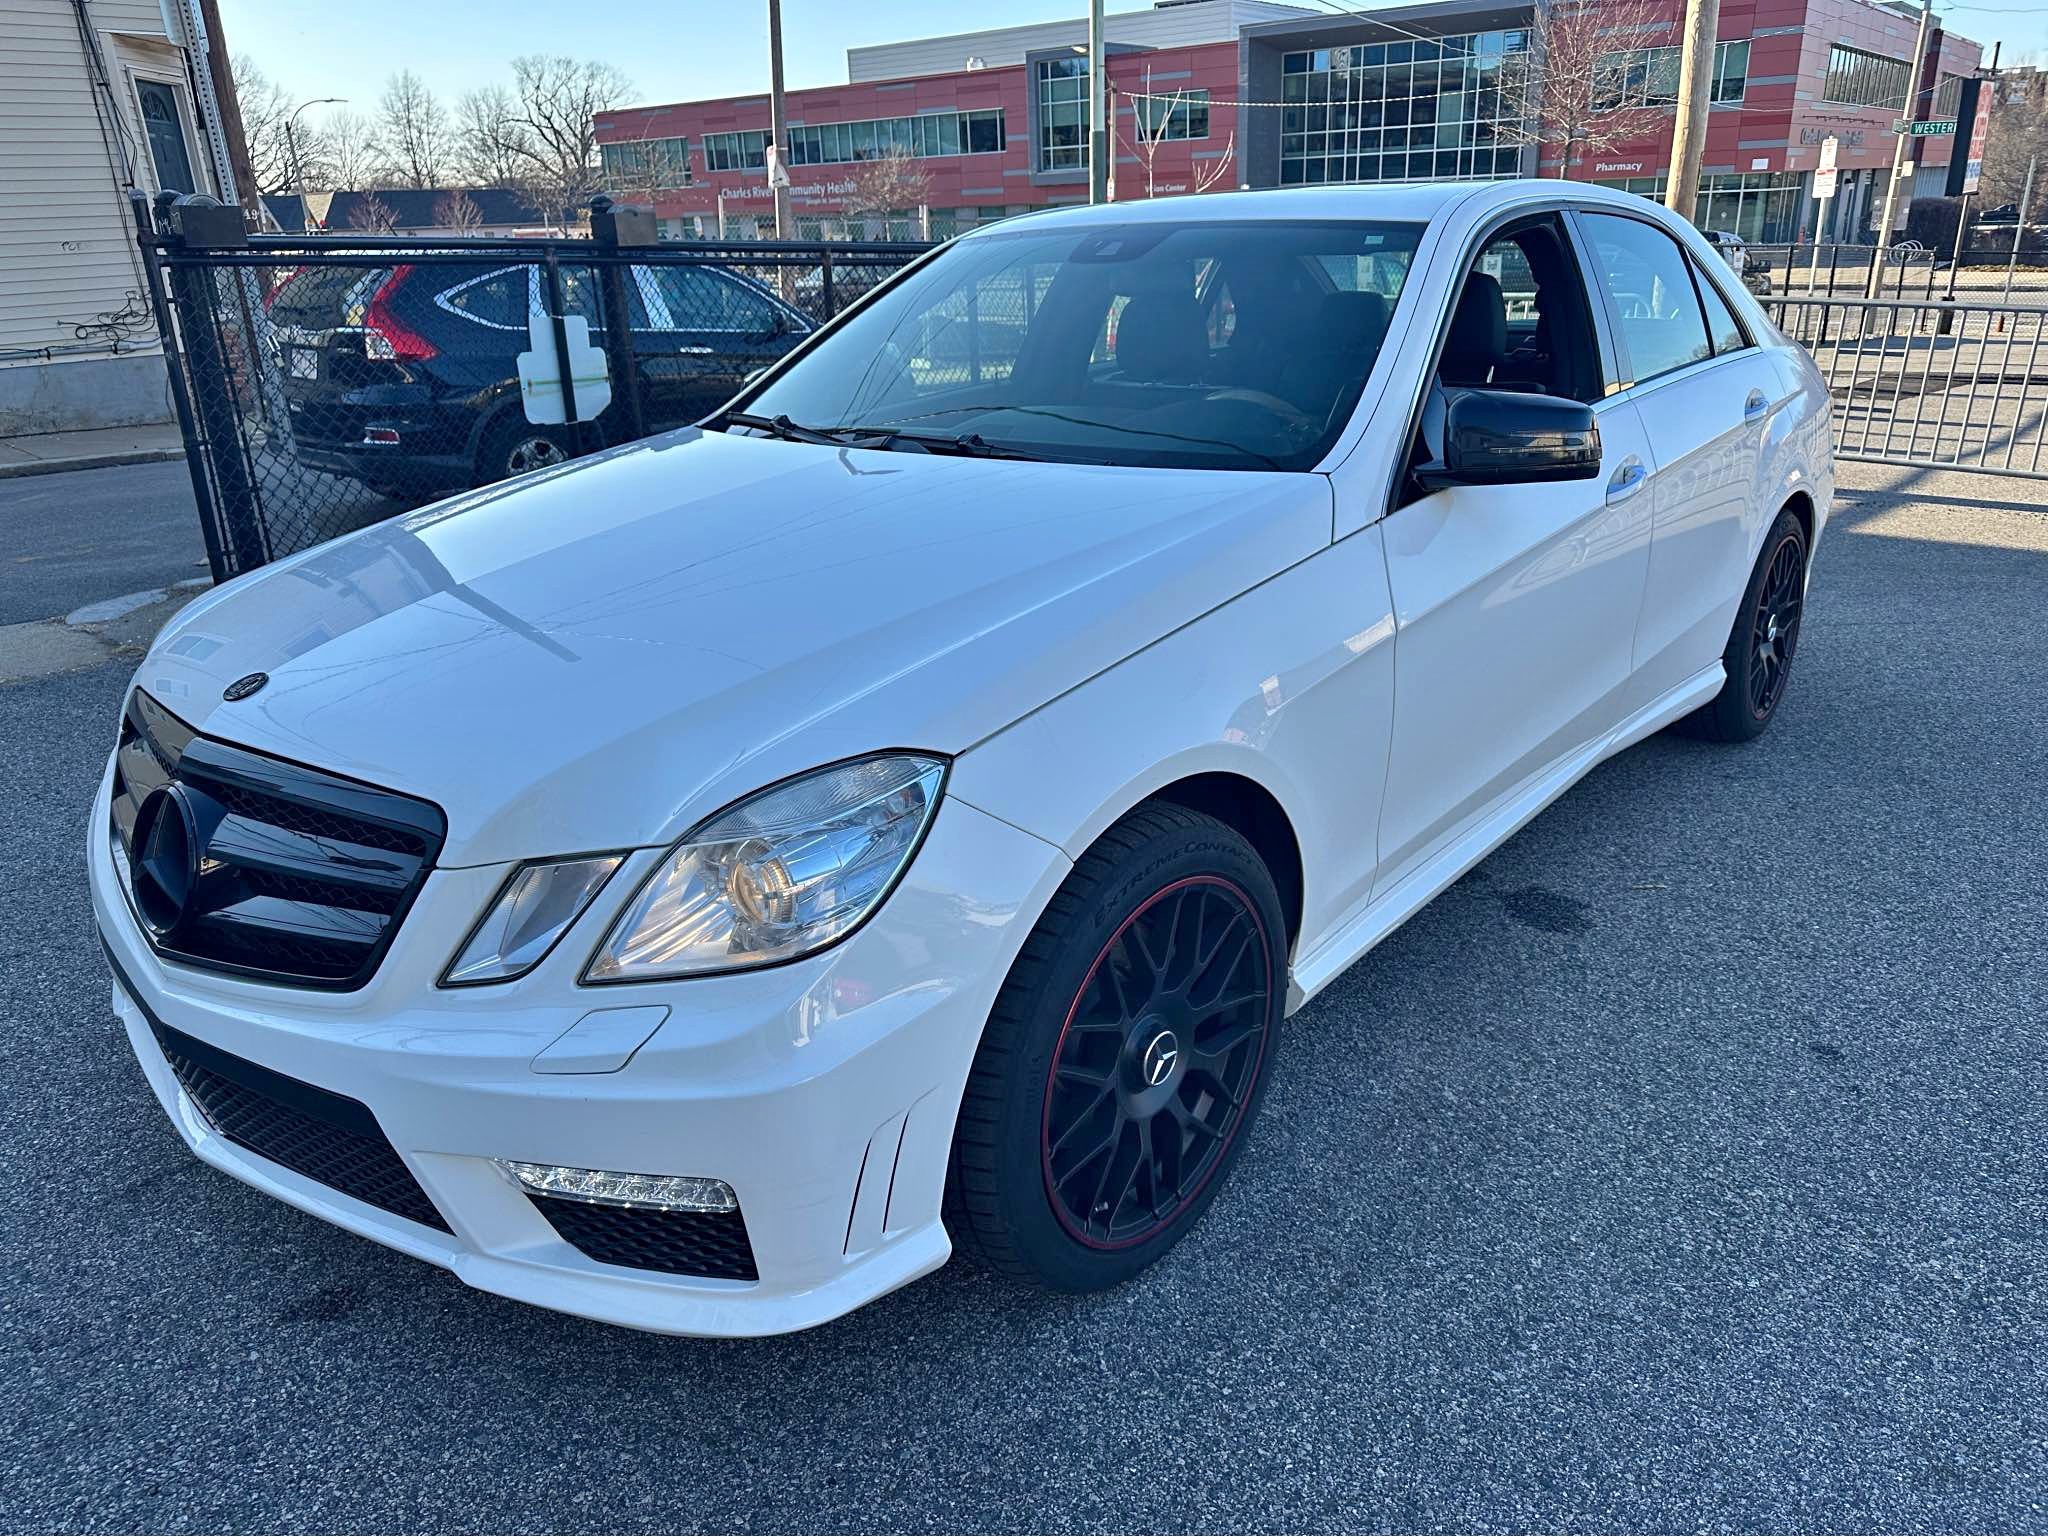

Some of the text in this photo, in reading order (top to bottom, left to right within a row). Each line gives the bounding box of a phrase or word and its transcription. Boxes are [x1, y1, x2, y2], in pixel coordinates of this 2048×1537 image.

[1595, 162, 1643, 172] Pharmacy
[721, 187, 752, 199] Charles
[788, 182, 826, 197] mmunity
[827, 180, 857, 193] Health
[1144, 184, 1164, 192] Vion
